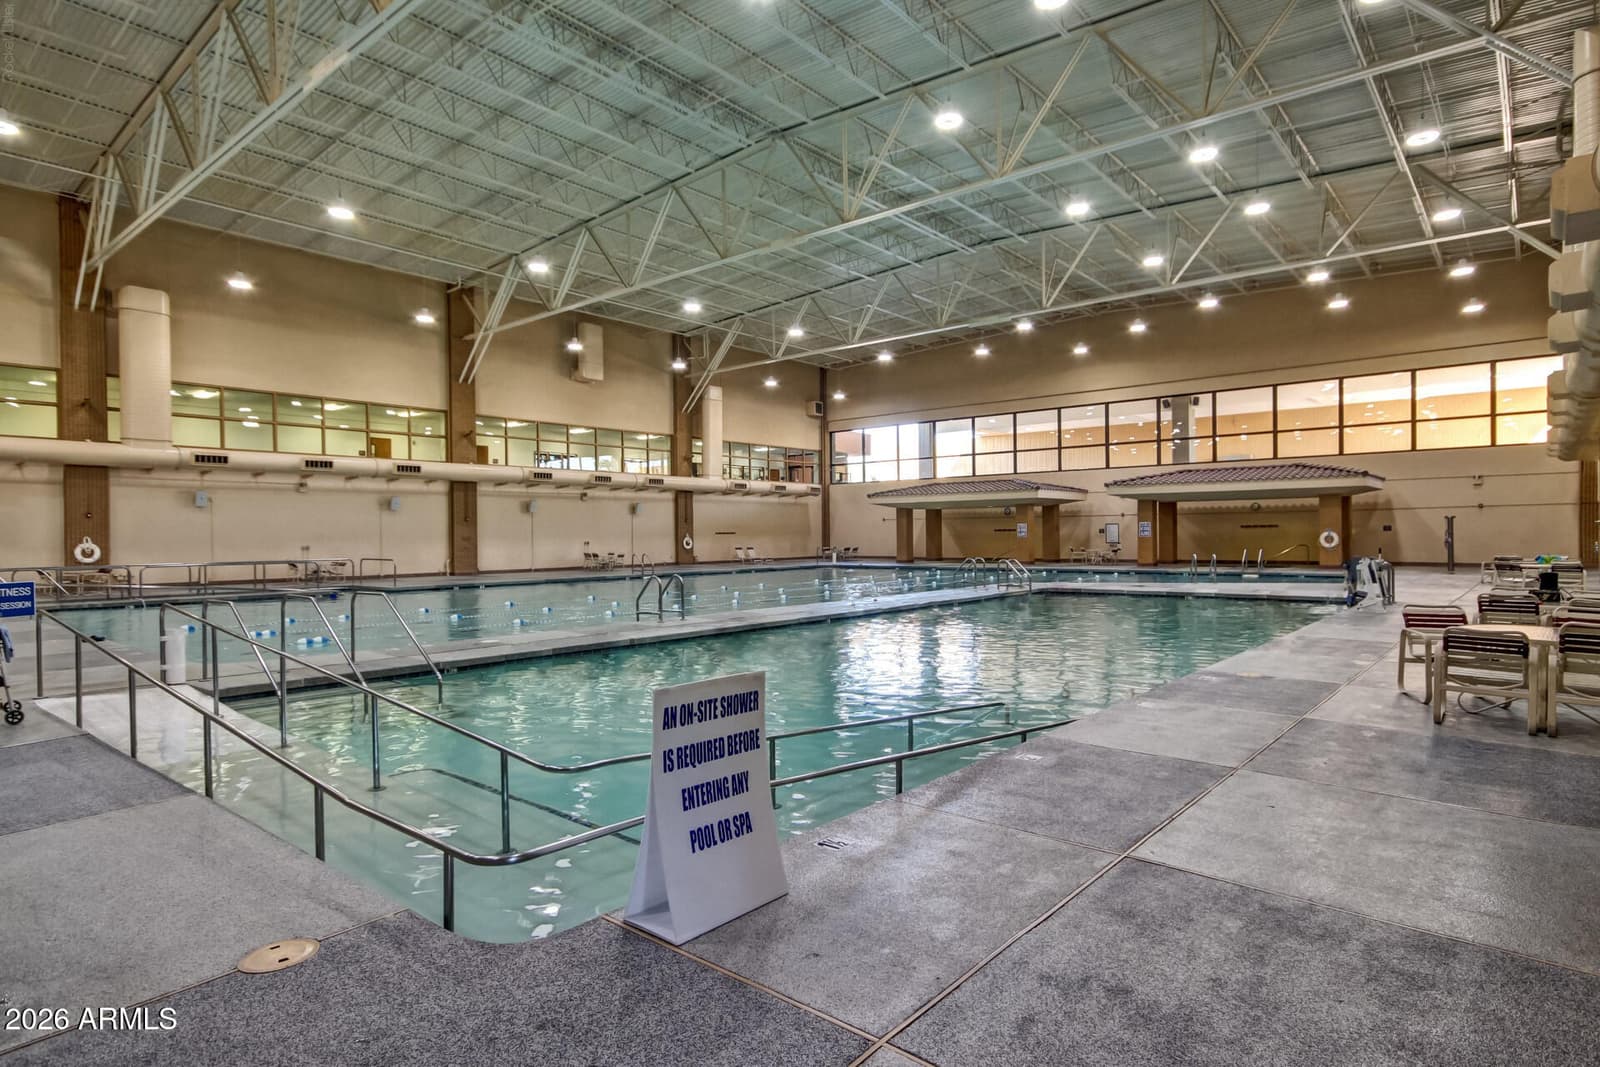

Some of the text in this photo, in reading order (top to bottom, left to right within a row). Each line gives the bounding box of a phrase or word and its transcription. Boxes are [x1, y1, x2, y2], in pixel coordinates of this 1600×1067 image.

[663, 690, 759, 731] AN ON-SITE SHOWER
[663, 728, 760, 773] IS REQUIRED BEFORE
[681, 770, 749, 812] ENTERING ANY
[689, 811, 753, 854] POOL OR SPA
